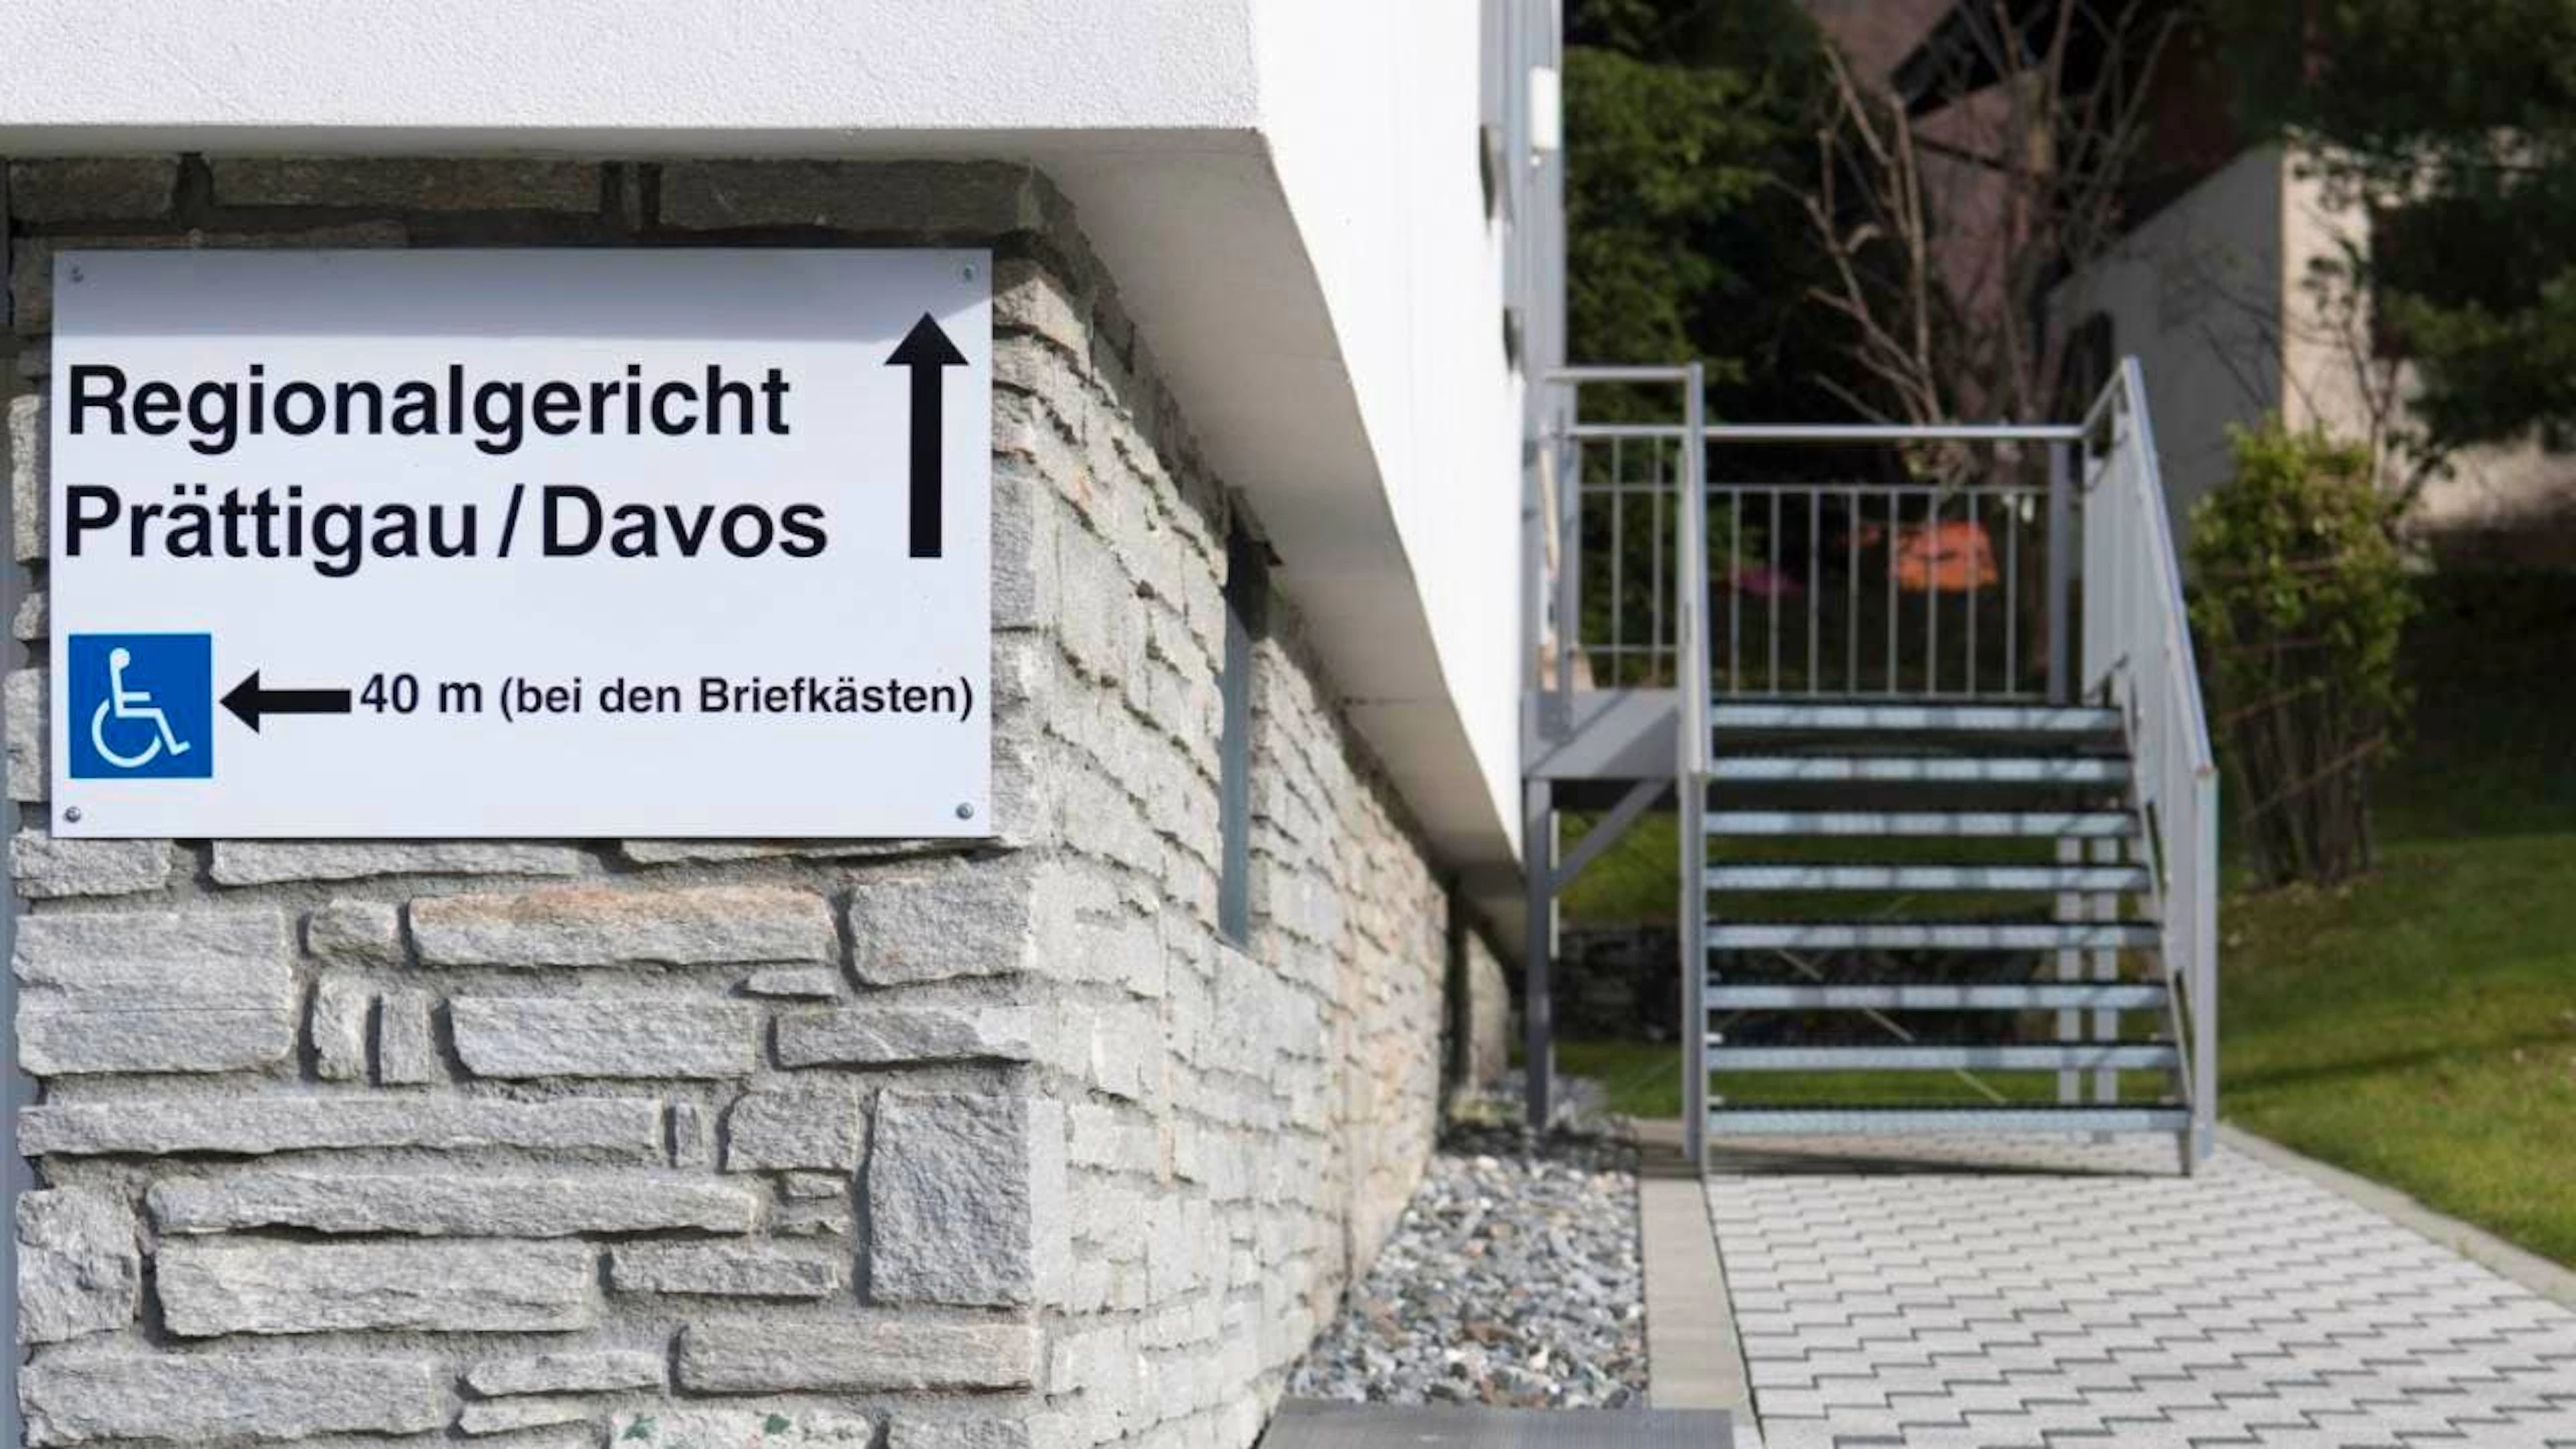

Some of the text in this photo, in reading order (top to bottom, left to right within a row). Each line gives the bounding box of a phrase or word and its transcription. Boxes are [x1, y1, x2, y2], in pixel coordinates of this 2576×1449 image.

[69, 364, 790, 455] Regionalgericht
[360, 673, 973, 722] 40 m (bei den Briefkästen)
